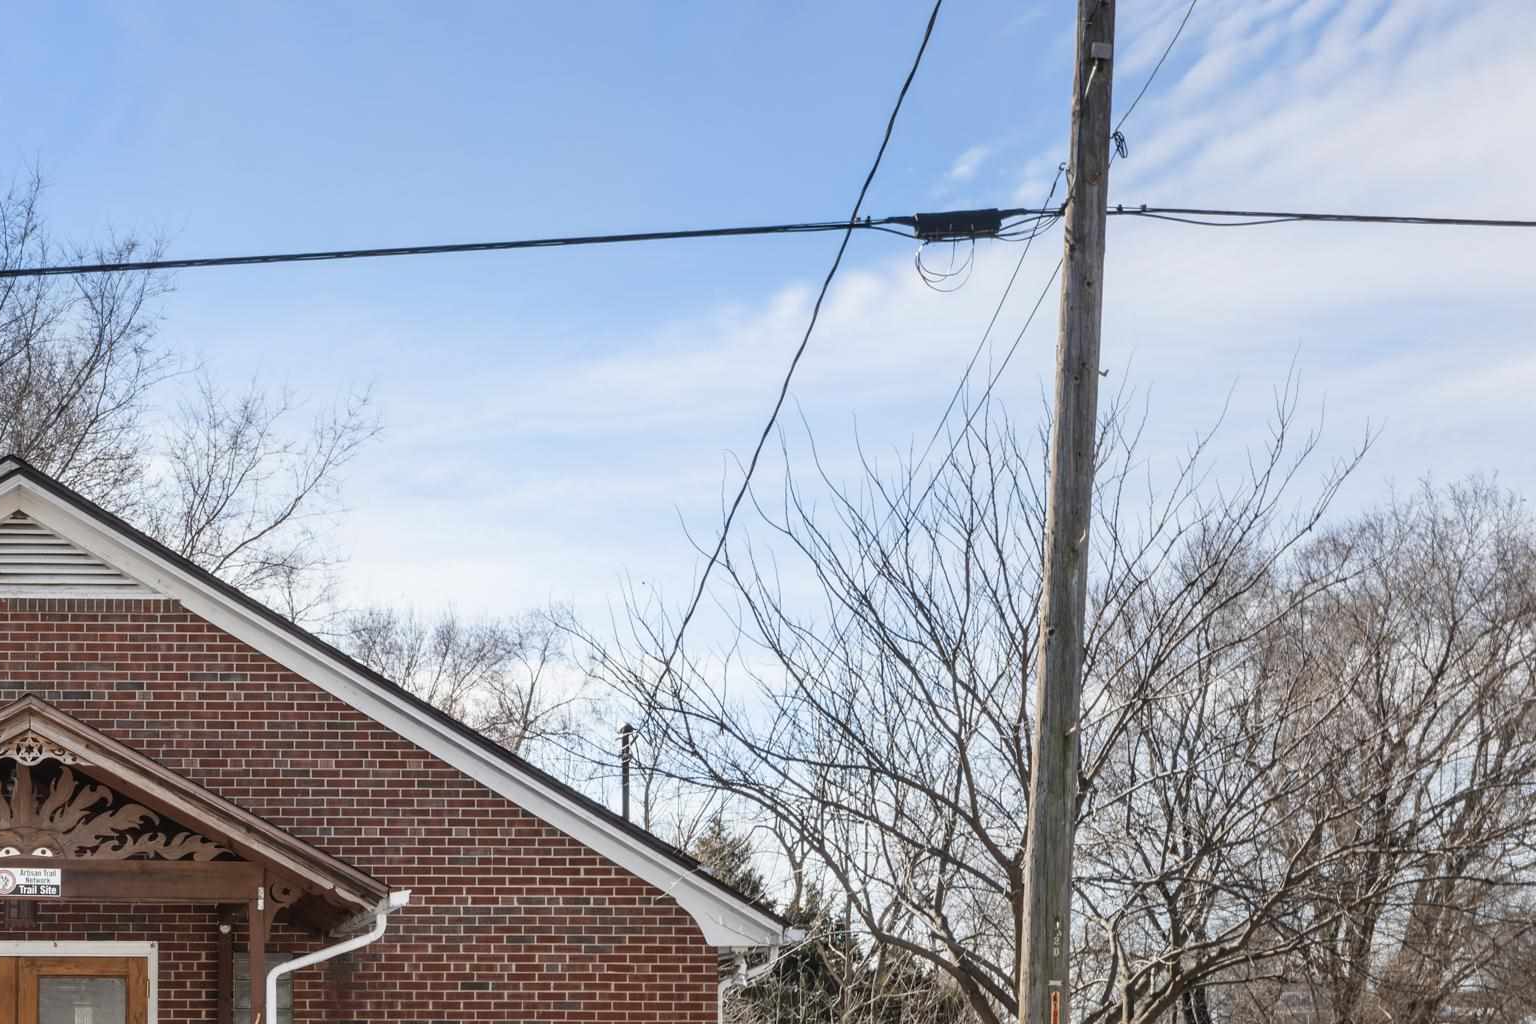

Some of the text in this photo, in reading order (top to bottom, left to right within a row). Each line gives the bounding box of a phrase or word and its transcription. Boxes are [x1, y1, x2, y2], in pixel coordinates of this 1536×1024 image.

[44, 869, 57, 877] Trail
[19, 885, 57, 895] Trail Site
